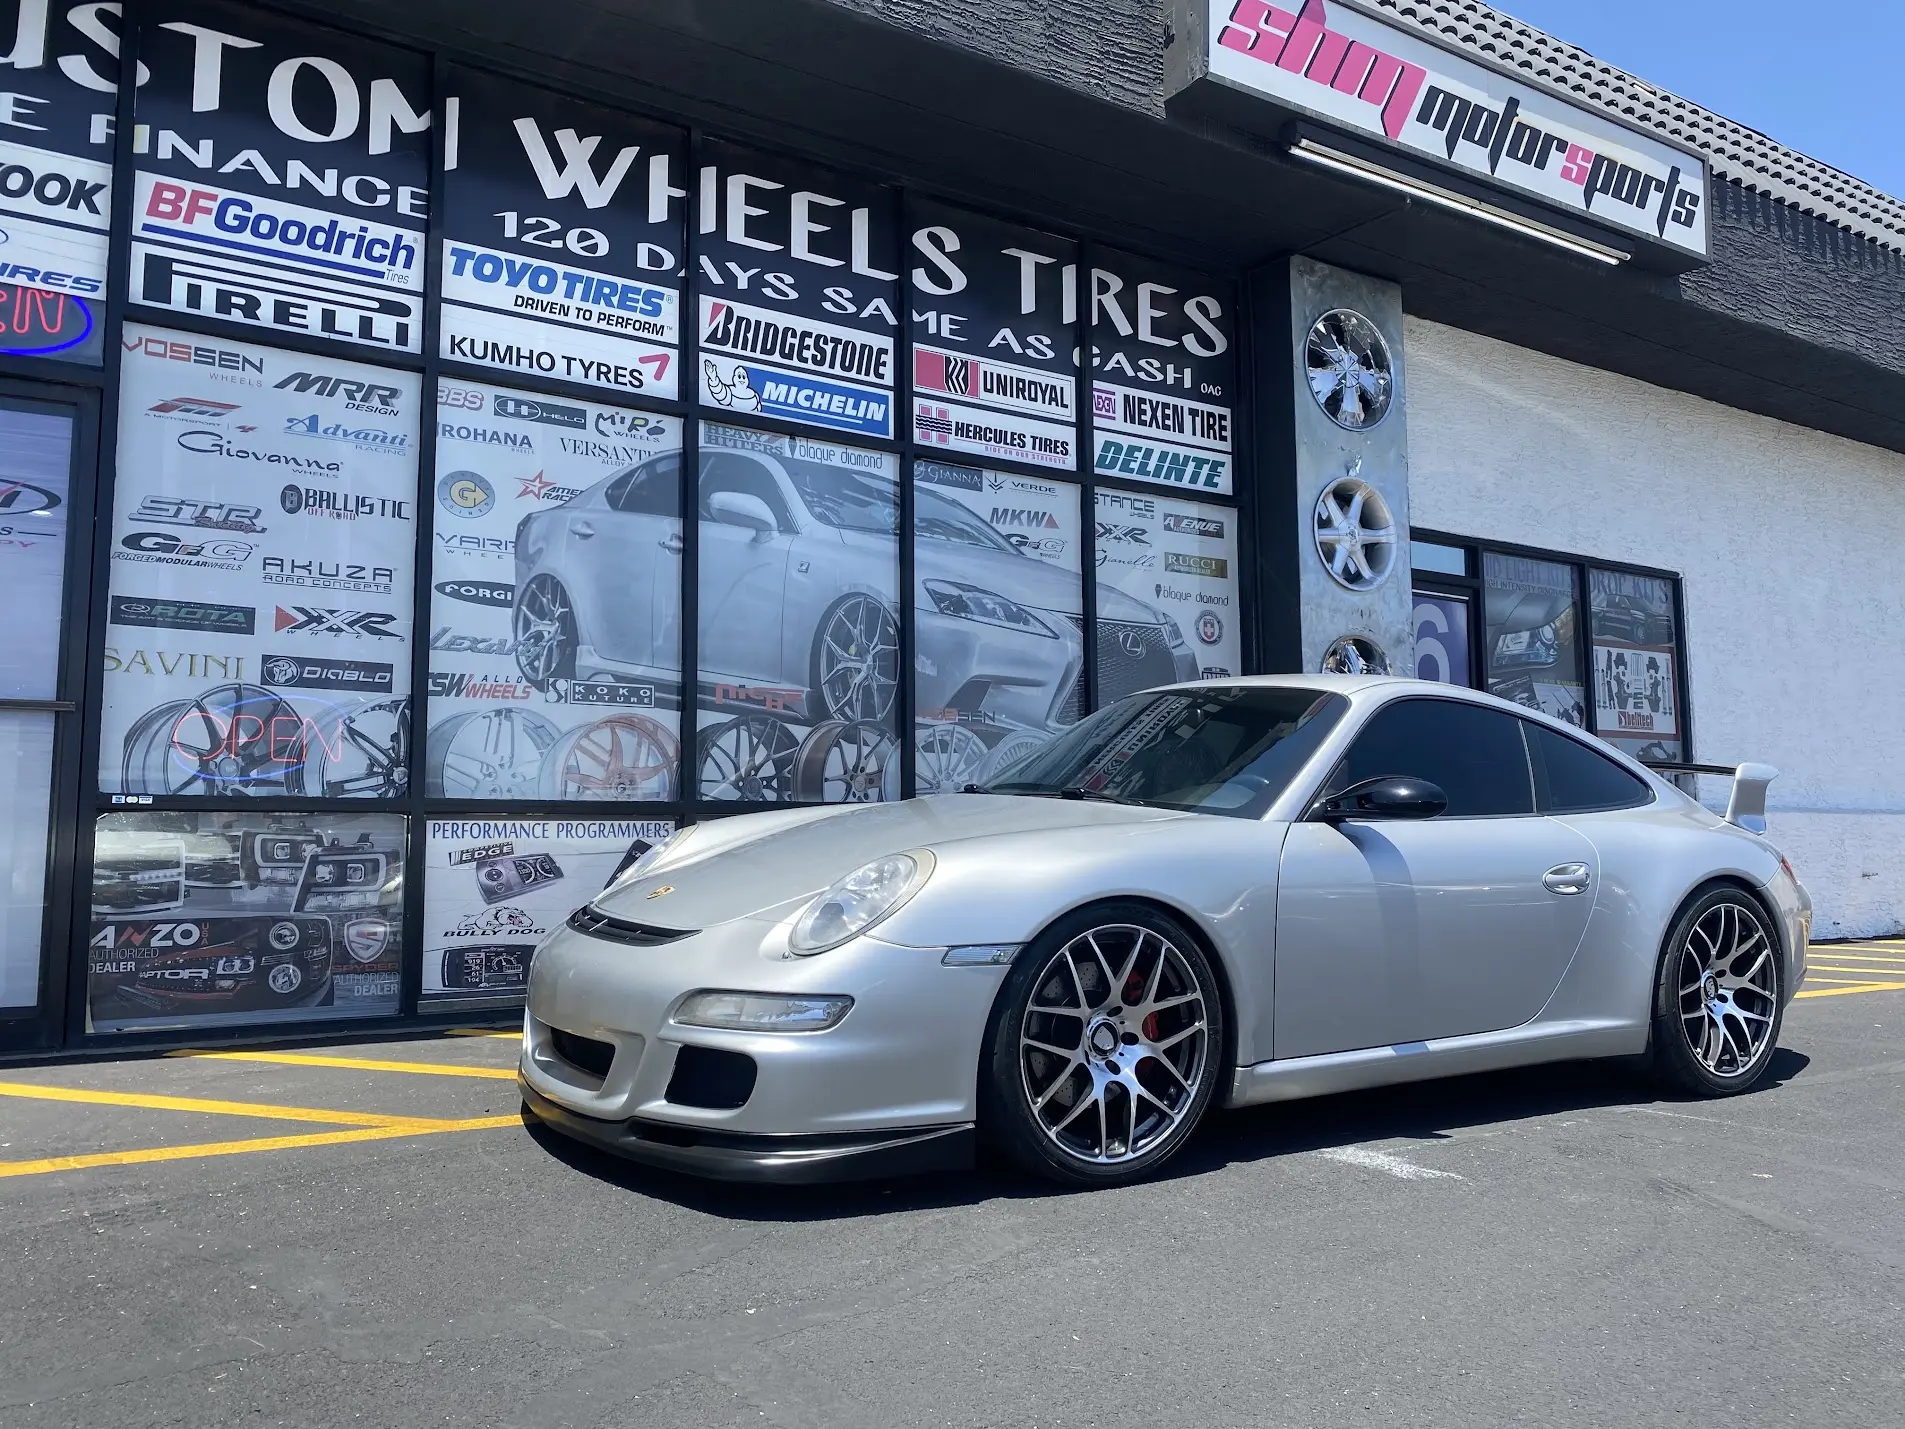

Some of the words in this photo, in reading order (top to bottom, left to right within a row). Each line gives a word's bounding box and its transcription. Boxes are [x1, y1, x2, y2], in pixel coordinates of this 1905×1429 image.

[1416, 84, 1700, 238] motorsports
[145, 181, 416, 270] BFGoodrich
[513, 117, 967, 295] WHEELS
[1001, 247, 1228, 358] TIRES
[90, 114, 429, 219] FINANCE
[493, 211, 610, 257] 120
[637, 242, 799, 301] DAYS
[821, 287, 968, 342] SAME
[988, 328, 1055, 360] AS
[1072, 346, 1192, 389] CASH
[1200, 382, 1222, 397] OAC
[386, 268, 410, 285] Tires
[143, 251, 412, 347] PIRELLI
[513, 293, 572, 322] DRIVEN
[574, 304, 593, 323] TO
[597, 311, 665, 337] PERFORM
[704, 302, 889, 380] BRIDGESTONE
[122, 336, 264, 375] VOSSEN
[449, 334, 556, 372] KUMHO
[562, 354, 644, 389] TYRES
[209, 372, 263, 388] WHEELS
[272, 371, 402, 408] MRR
[982, 370, 1069, 409] UNIROYAL
[344, 402, 400, 417] DESIGN
[762, 380, 886, 422] MICHELIN
[543, 411, 585, 424] HELO
[1123, 393, 1185, 434] NEXEN
[1188, 406, 1228, 442] TIRE
[284, 413, 408, 446] Advanti
[441, 423, 533, 449] ROHANA
[613, 430, 660, 443] WHEELS
[705, 423, 763, 443] HEAVY
[954, 421, 1027, 449] HERCULES
[1030, 434, 1070, 456] TIRES
[178, 430, 341, 471] Giovanna
[355, 444, 407, 457] RACING
[705, 434, 784, 455] HITTERS
[840, 448, 883, 469] diamond
[1095, 439, 1226, 489] DELINTE
[292, 468, 339, 479] WHEELS
[928, 465, 982, 487] GIANNA
[1011, 481, 1057, 494] VERDE
[303, 487, 411, 521] BALLISTIC
[307, 506, 325, 517] OFF
[1094, 492, 1155, 513] STANCE
[989, 507, 1047, 528] MKW
[262, 556, 393, 583] AKUZA
[1167, 554, 1217, 570] RUCCI
[262, 574, 305, 585] ROAD
[312, 579, 392, 593] CONCEPTS
[1500, 580, 1536, 593] INTENSITY
[1195, 591, 1229, 606] diamond
[150, 605, 246, 623] ROTA
[104, 647, 245, 681] SAVINI
[302, 666, 392, 683] DIABLO
[465, 682, 533, 700] WHEELS
[574, 693, 651, 704] KUTURE
[575, 685, 651, 697] KOKO
[174, 712, 343, 763] OPEN
[432, 822, 550, 840] PERFORMANCE
[556, 822, 670, 840] PROGRAMMERS
[461, 844, 513, 861] EDGE
[90, 922, 200, 949] ANZO
[201, 922, 210, 946] USA
[443, 929, 502, 938] BULLY
[506, 928, 546, 936] DOG
[90, 948, 159, 961] AUTHORIZED
[90, 961, 136, 974] DEALER
[333, 971, 399, 985] AUTHORIZED
[354, 983, 398, 997] DEALER
